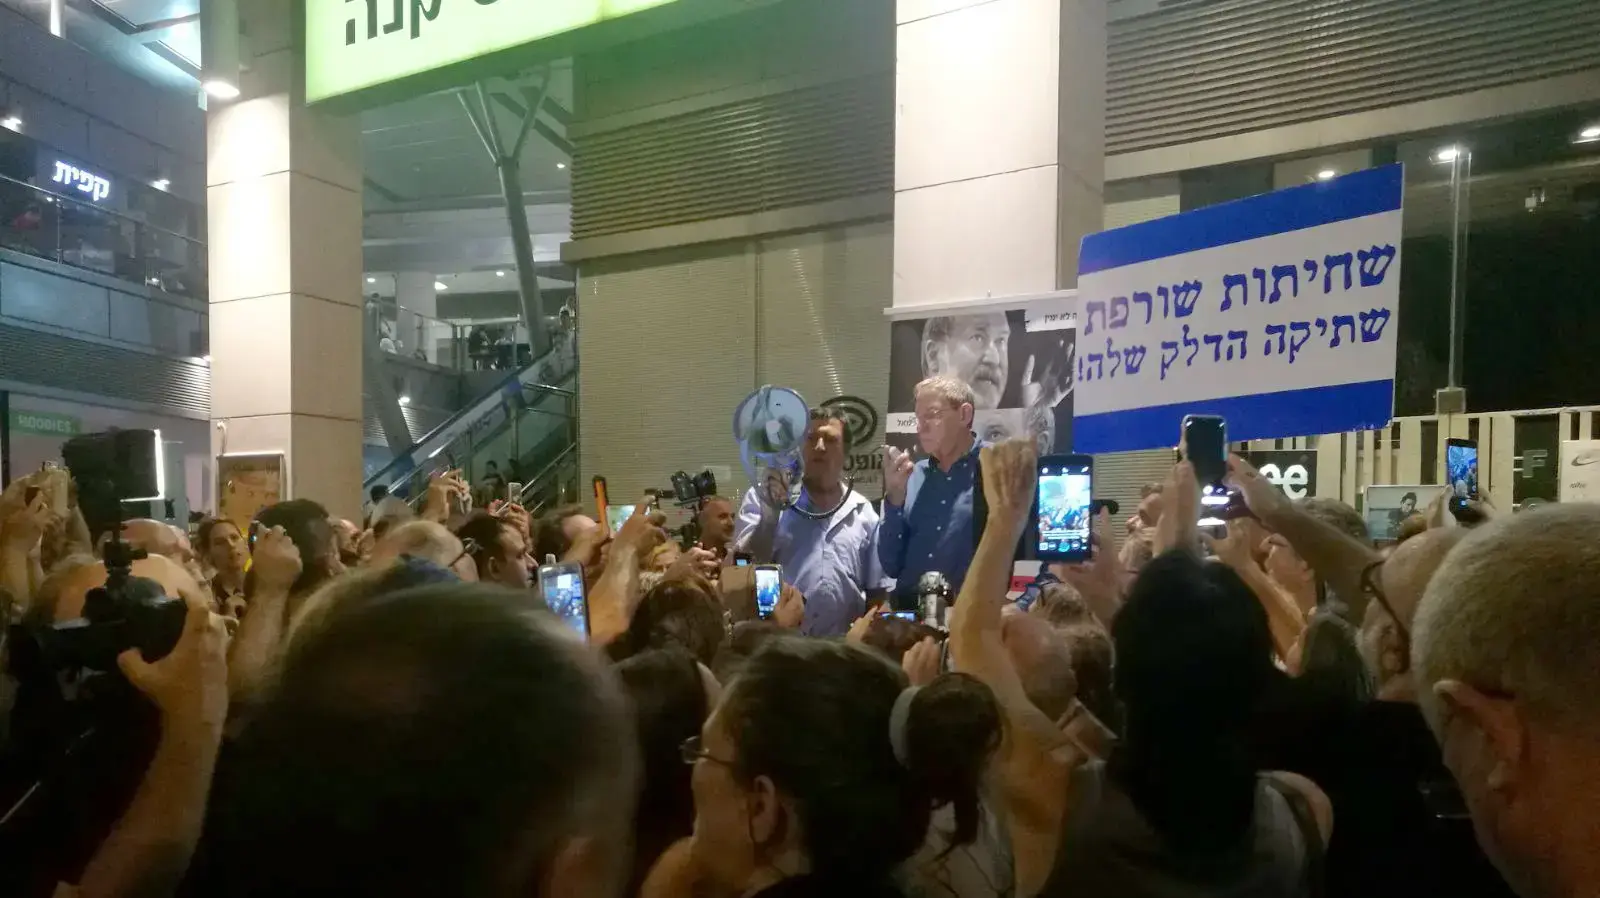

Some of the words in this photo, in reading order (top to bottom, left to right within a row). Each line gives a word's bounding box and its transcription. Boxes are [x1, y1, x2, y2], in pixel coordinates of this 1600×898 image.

[52, 160, 110, 201] קפית
[1220, 243, 1396, 312] שחיתות
[1084, 279, 1203, 336] שורפת
[1264, 307, 1391, 364] שתיקה
[1078, 337, 1147, 382] שלה!
[1160, 324, 1248, 381] הדלק
[1259, 463, 1308, 500] ee
